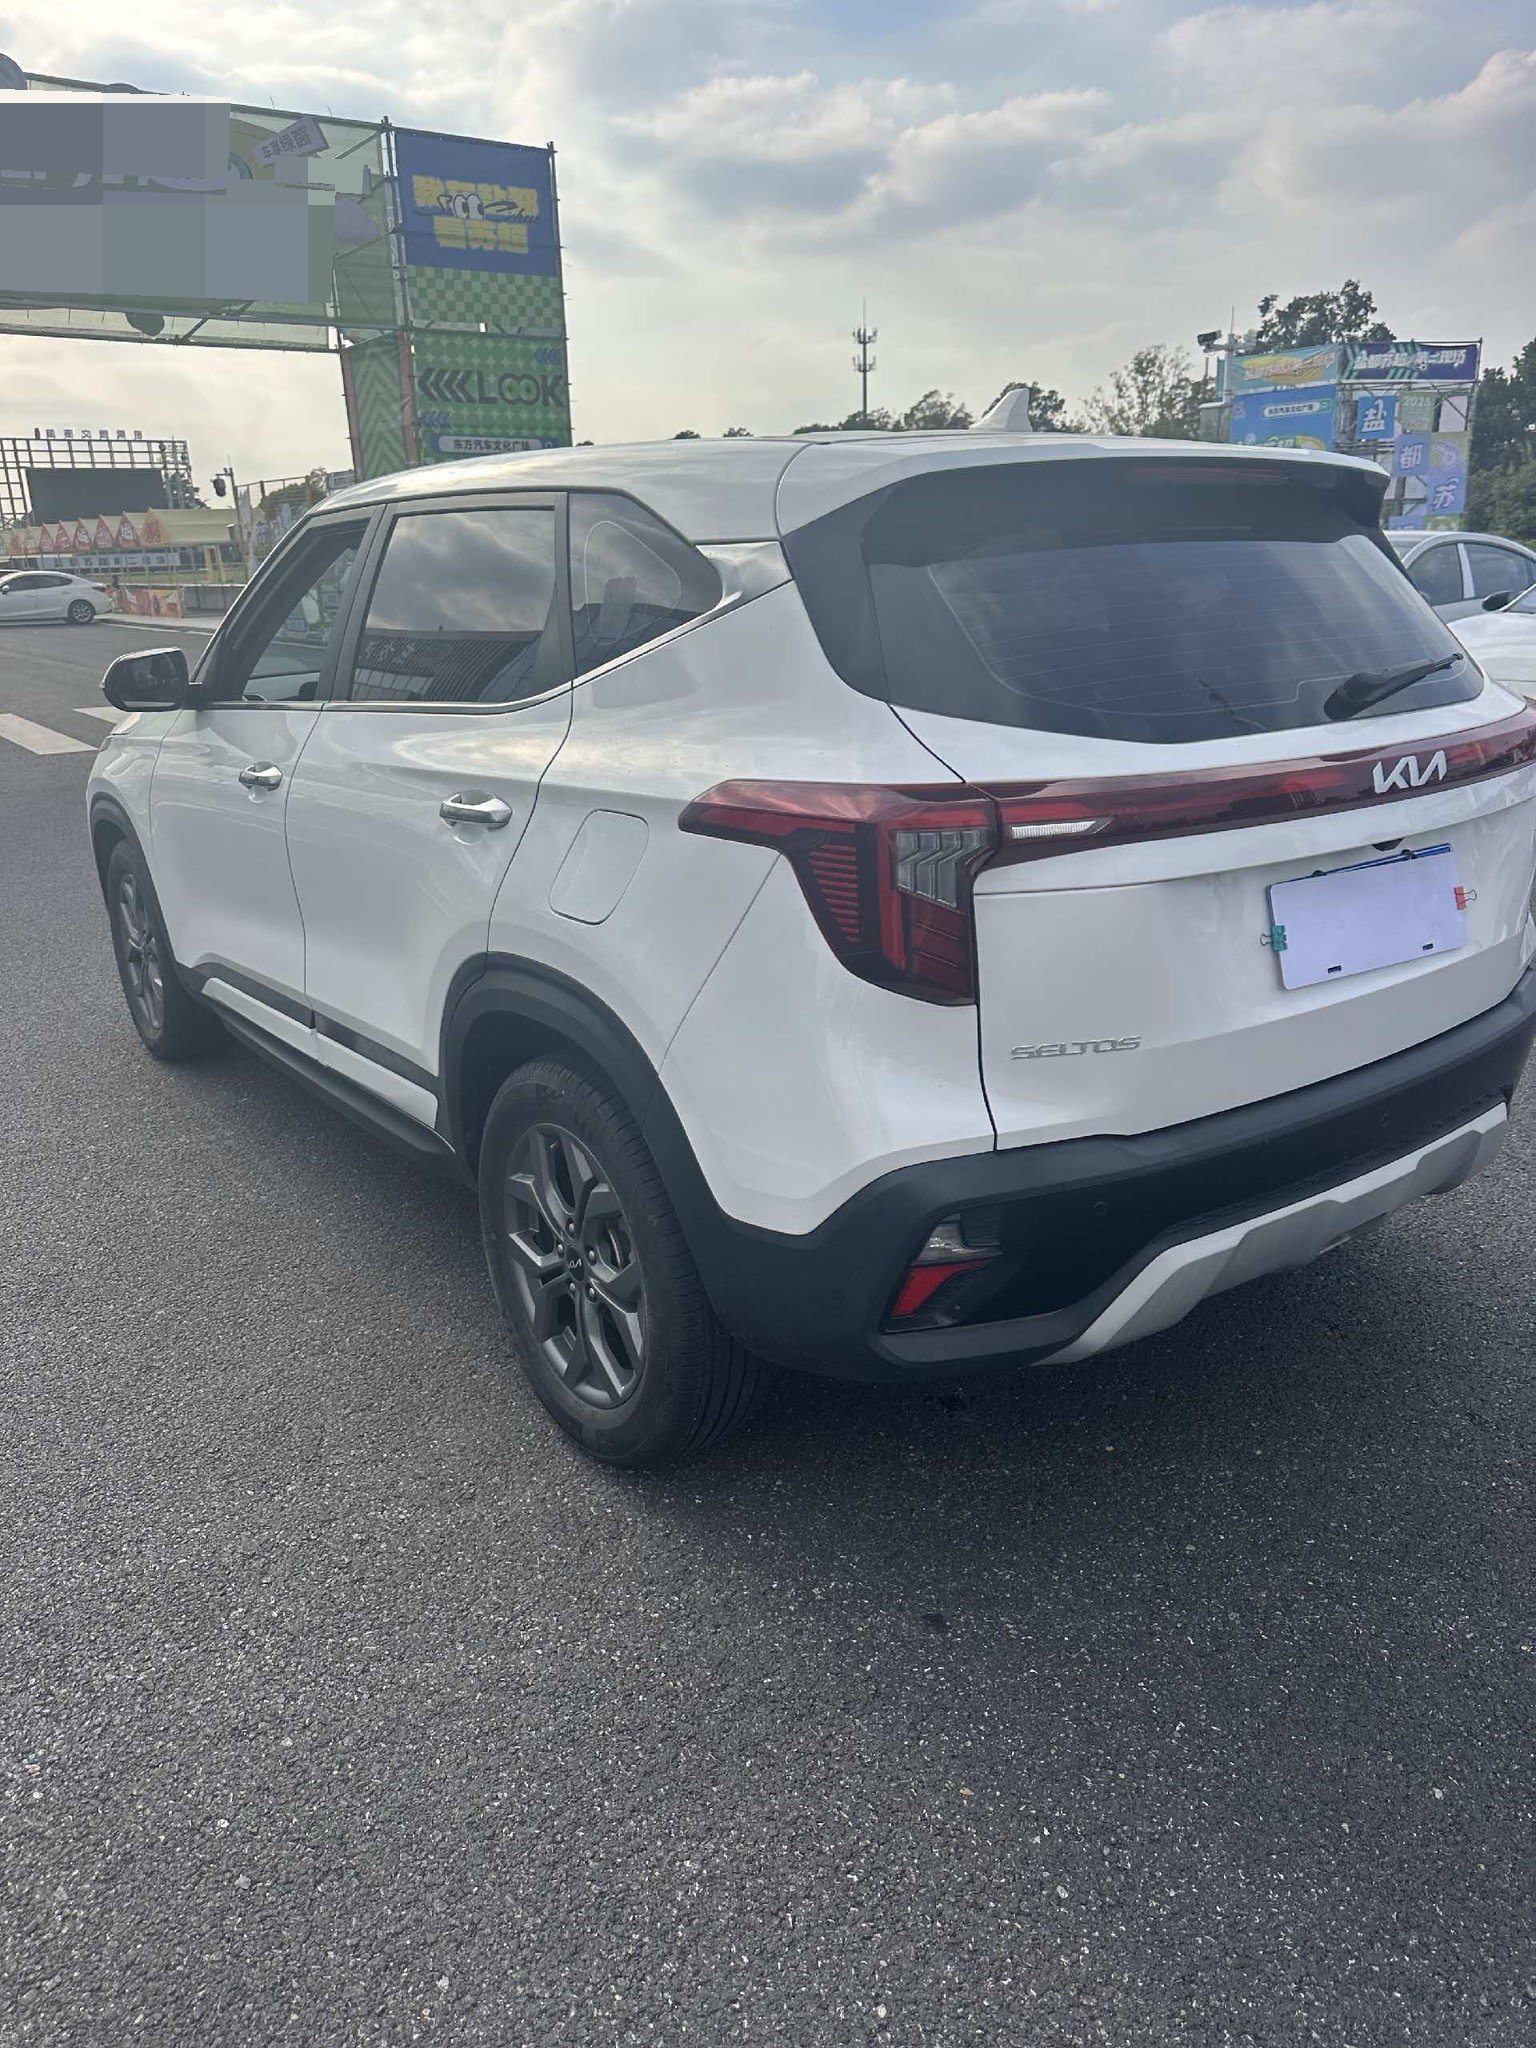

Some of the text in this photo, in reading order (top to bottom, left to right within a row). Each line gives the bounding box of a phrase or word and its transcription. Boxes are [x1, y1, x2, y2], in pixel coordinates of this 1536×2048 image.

[476, 370, 565, 407] LOOK
[1400, 443, 1424, 470] 都
[1432, 477, 1460, 511] 苏
[1373, 750, 1447, 794] KIA
[1010, 1035, 1142, 1060] SELTOS
